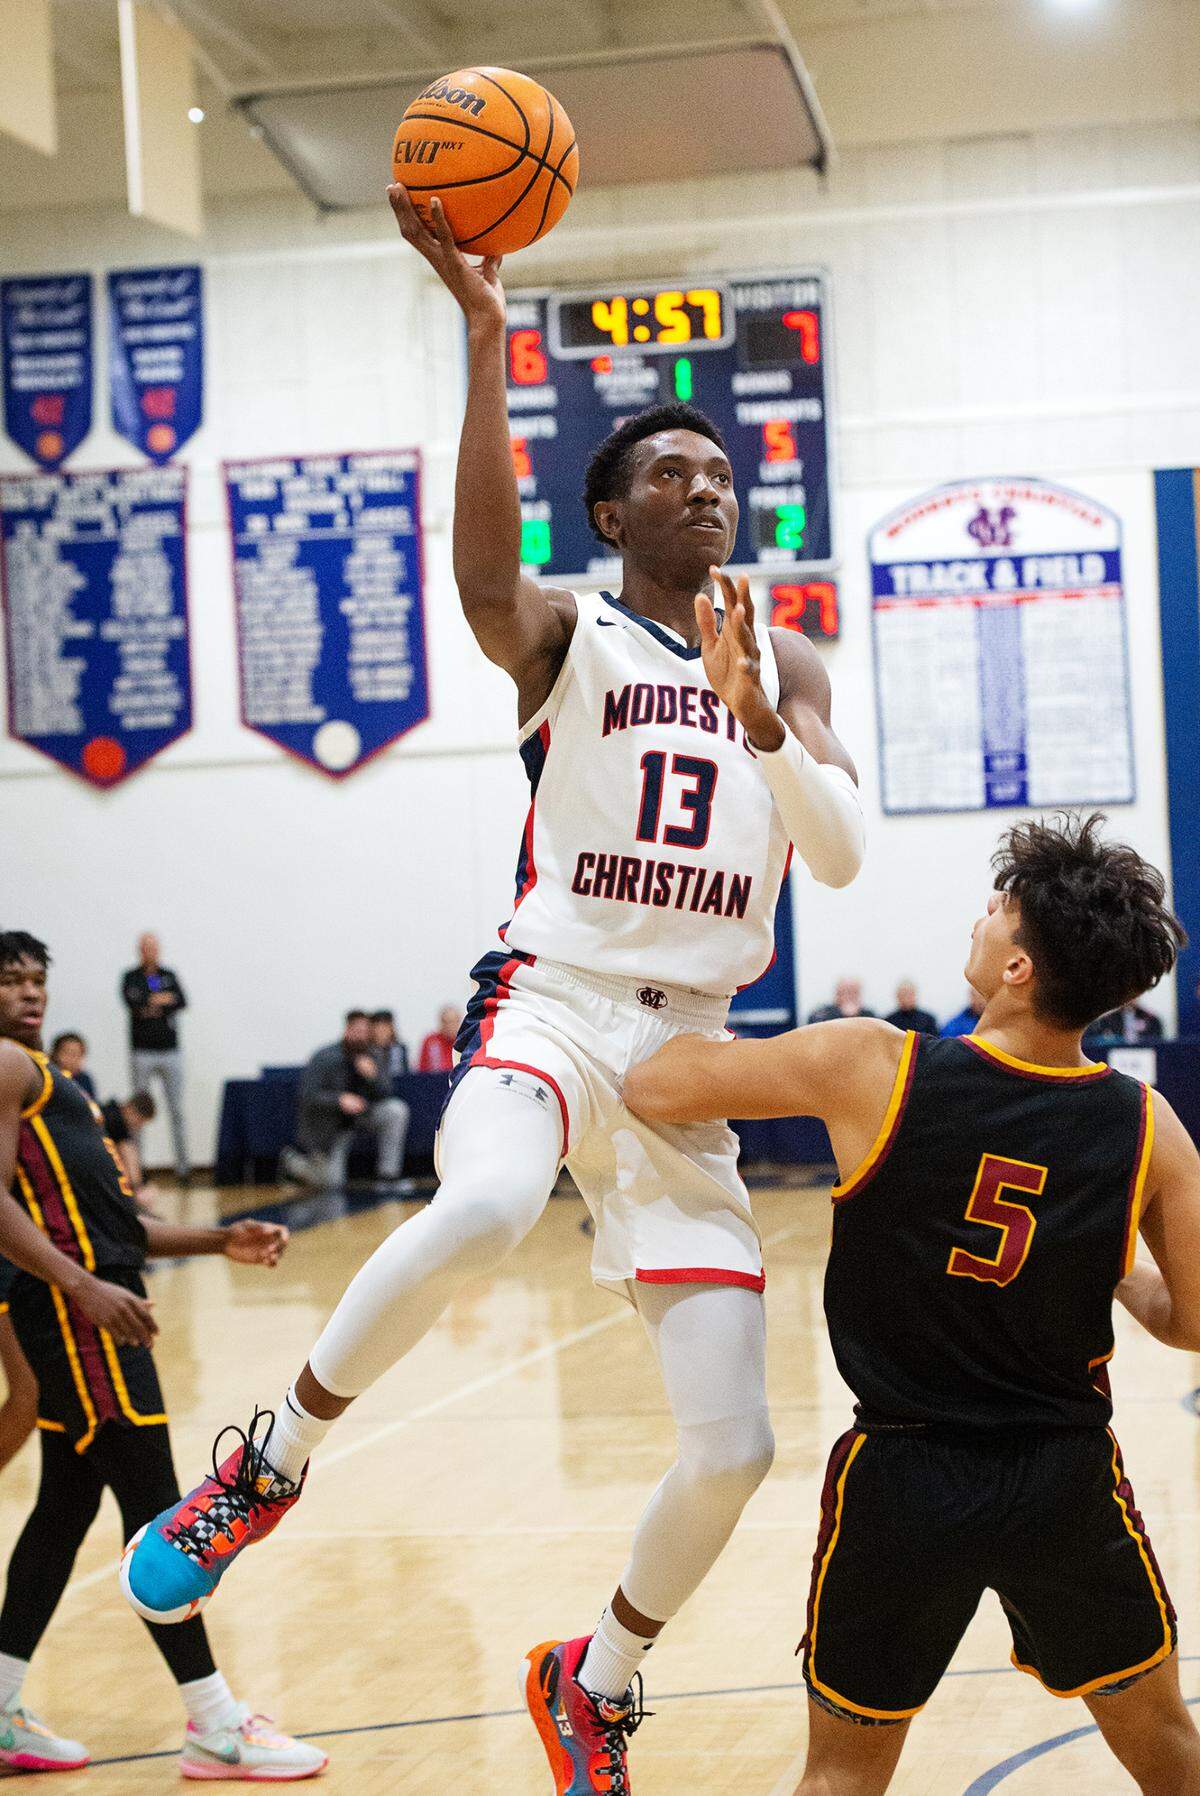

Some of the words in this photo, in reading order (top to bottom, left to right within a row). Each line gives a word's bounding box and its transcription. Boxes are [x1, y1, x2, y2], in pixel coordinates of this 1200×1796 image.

[394, 139, 440, 164] EVO
[441, 141, 465, 150] NXT
[590, 288, 722, 346] 4:57
[782, 310, 820, 365] 7
[510, 329, 548, 385] 6
[674, 357, 693, 401] 1
[762, 418, 797, 464] 5
[890, 561, 988, 593] TRACK
[770, 581, 839, 636] 27
[602, 683, 757, 759] MODES
[635, 750, 719, 850] 13
[571, 852, 752, 919] CHRISTIAN
[946, 1152, 1048, 1287] 5
